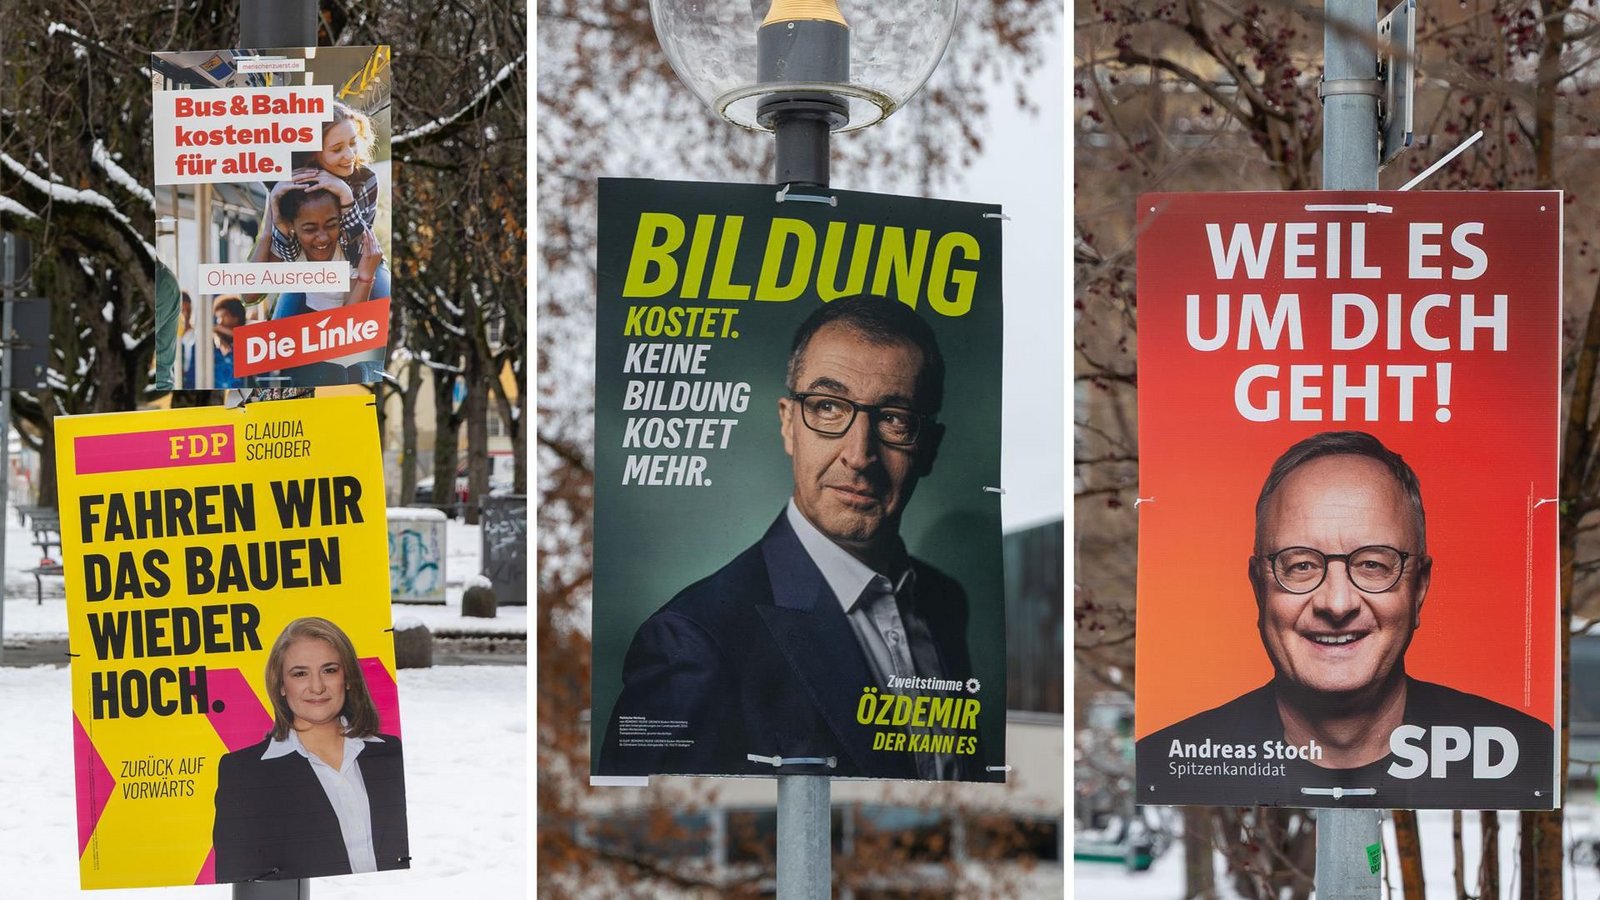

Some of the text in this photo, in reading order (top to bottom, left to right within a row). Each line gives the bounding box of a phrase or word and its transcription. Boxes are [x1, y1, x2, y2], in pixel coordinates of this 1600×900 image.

[175, 123, 313, 147] kostenlos
[175, 152, 282, 176] für alle.
[622, 212, 981, 318] BILDUNG
[1206, 222, 1488, 280] WEIL ES
[207, 268, 341, 287] Ohne Ausrede.
[623, 306, 740, 340] KOSTET.
[1186, 294, 1509, 352] UM DICH
[246, 317, 379, 364] Die Linke
[622, 343, 712, 375] KEINE
[622, 380, 752, 413] BILDUNG
[1234, 363, 1452, 423] GEHT!
[169, 433, 229, 460] FDP
[245, 420, 304, 441] CLAUDIA
[622, 417, 739, 450] KOSTET
[246, 440, 311, 462] SCHOBER
[622, 454, 712, 487] MEHR.
[79, 476, 364, 544] FAHREN WIR
[83, 549, 171, 603] DAS
[184, 536, 342, 596] BAUEN
[87, 603, 263, 661] WIEDER
[91, 666, 226, 720] HOCH.
[887, 674, 963, 692] Zweitstimme
[856, 686, 981, 730] ÖZDEMIR
[872, 732, 978, 755] DER KANN ES
[1168, 738, 1323, 760] Andreas Stoch
[1386, 724, 1520, 780] SPD
[120, 754, 206, 779] ZURÜCK AUF
[1169, 761, 1287, 778] Spitzenkandidat
[122, 776, 195, 800] VORWÄRTS
